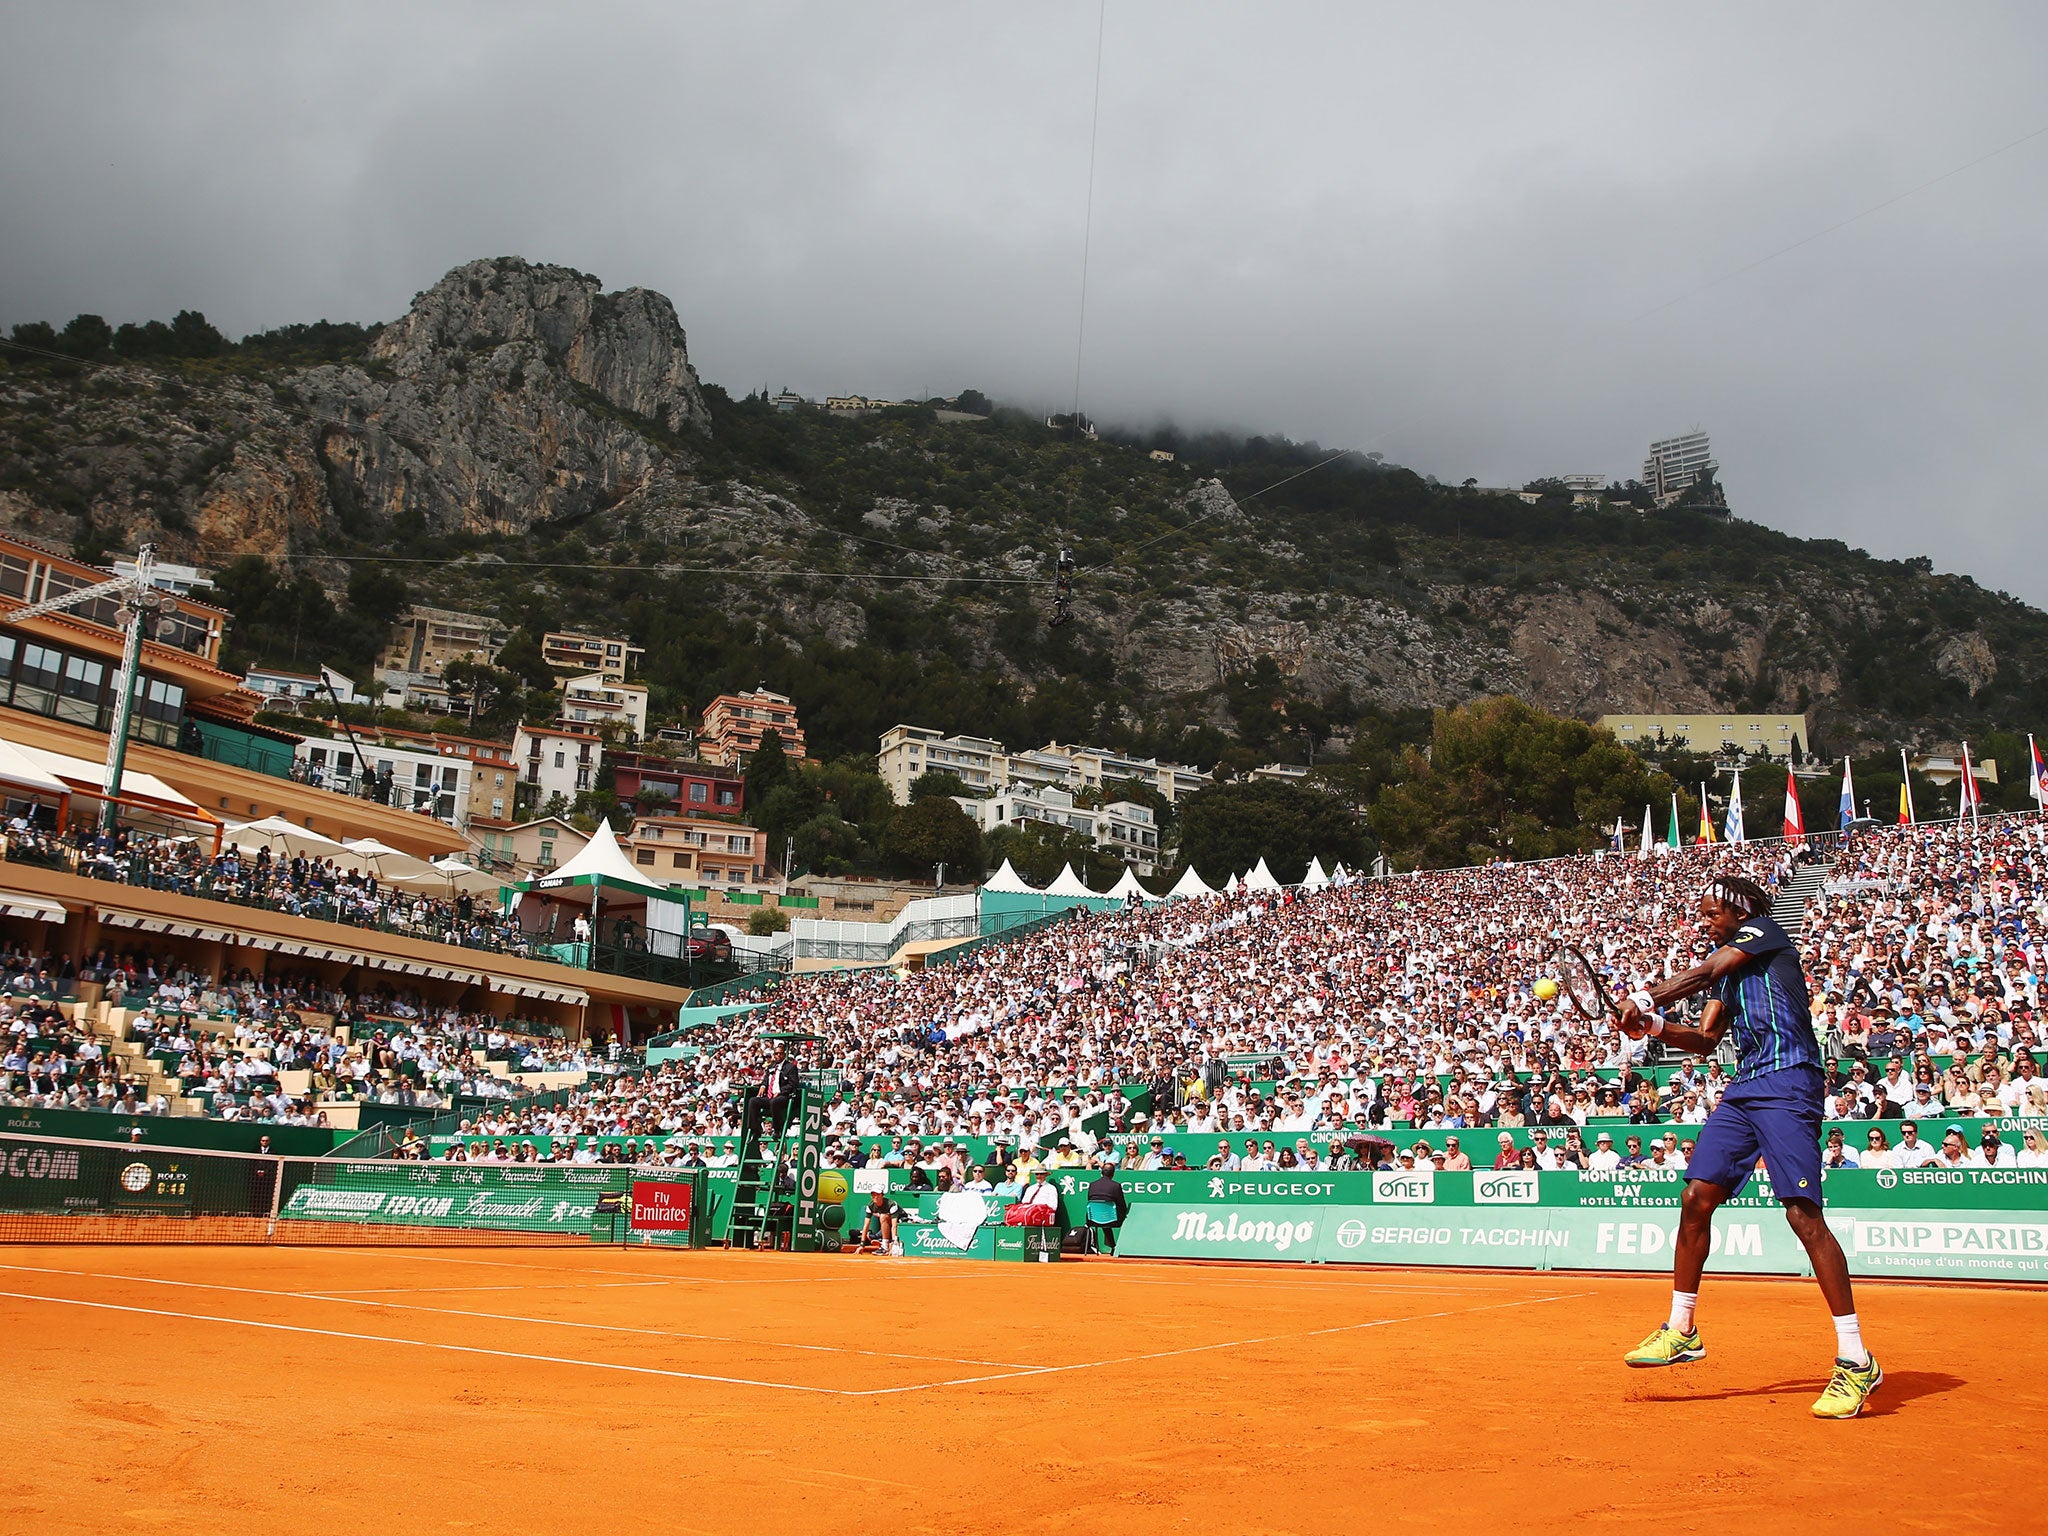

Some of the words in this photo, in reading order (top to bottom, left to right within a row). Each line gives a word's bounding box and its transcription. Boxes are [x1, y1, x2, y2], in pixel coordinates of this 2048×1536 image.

[539, 878, 564, 889] CANAL+
[7, 1119, 42, 1129] ROLEX
[1110, 1134, 1149, 1146] TORONTO
[799, 1105, 820, 1225] RICOH
[156, 1173, 189, 1181] ROLEX
[1578, 1170, 1677, 1183] MONTE-CARLO
[1902, 1171, 1964, 1185] SERGIO
[1079, 1181, 1175, 1194] PGEOT
[1229, 1183, 1335, 1196] PEUGEOT
[1613, 1185, 1642, 1198] BAY
[654, 1191, 670, 1204] Fly
[1580, 1197, 1617, 1206] HOTEL
[1621, 1198, 1629, 1206] &
[1633, 1198, 1679, 1206] RESORT
[1766, 1198, 1774, 1206] &
[384, 1196, 455, 1217] FEDCOM
[635, 1203, 687, 1222] Emirates
[1171, 1211, 1315, 1251] Malongo
[1370, 1228, 1451, 1245] SERGIO
[1459, 1228, 1570, 1247] TACCHINI
[1866, 1226, 1932, 1248] BNP
[1943, 1227, 2048, 1251] PARIB
[1867, 1256, 1881, 1265] La
[1885, 1256, 1932, 1268] banque
[1936, 1257, 1963, 1267] d'un
[1968, 1258, 2014, 1269] monde
[2018, 1259, 2039, 1270] qui
